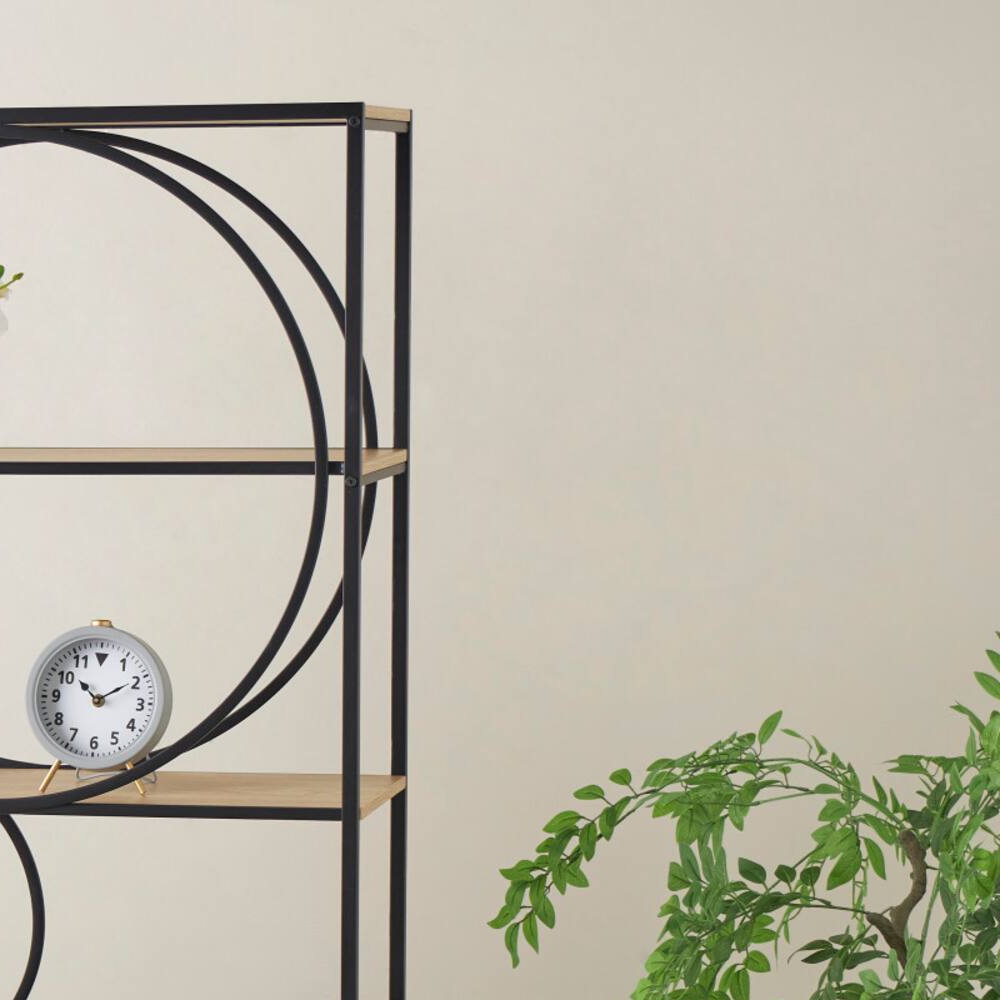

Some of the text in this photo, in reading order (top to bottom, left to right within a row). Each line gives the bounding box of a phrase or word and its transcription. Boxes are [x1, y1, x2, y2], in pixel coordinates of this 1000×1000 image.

[73, 654, 88, 668] 11
[120, 658, 127, 672] 1
[58, 670, 74, 684] 10
[131, 676, 140, 690] 2
[52, 689, 60, 703] 9
[135, 698, 145, 711] 3
[54, 712, 64, 726] 8
[126, 718, 136, 732] 4
[69, 728, 78, 742] 7
[110, 731, 119, 746] 5
[89, 736, 98, 750] 6
